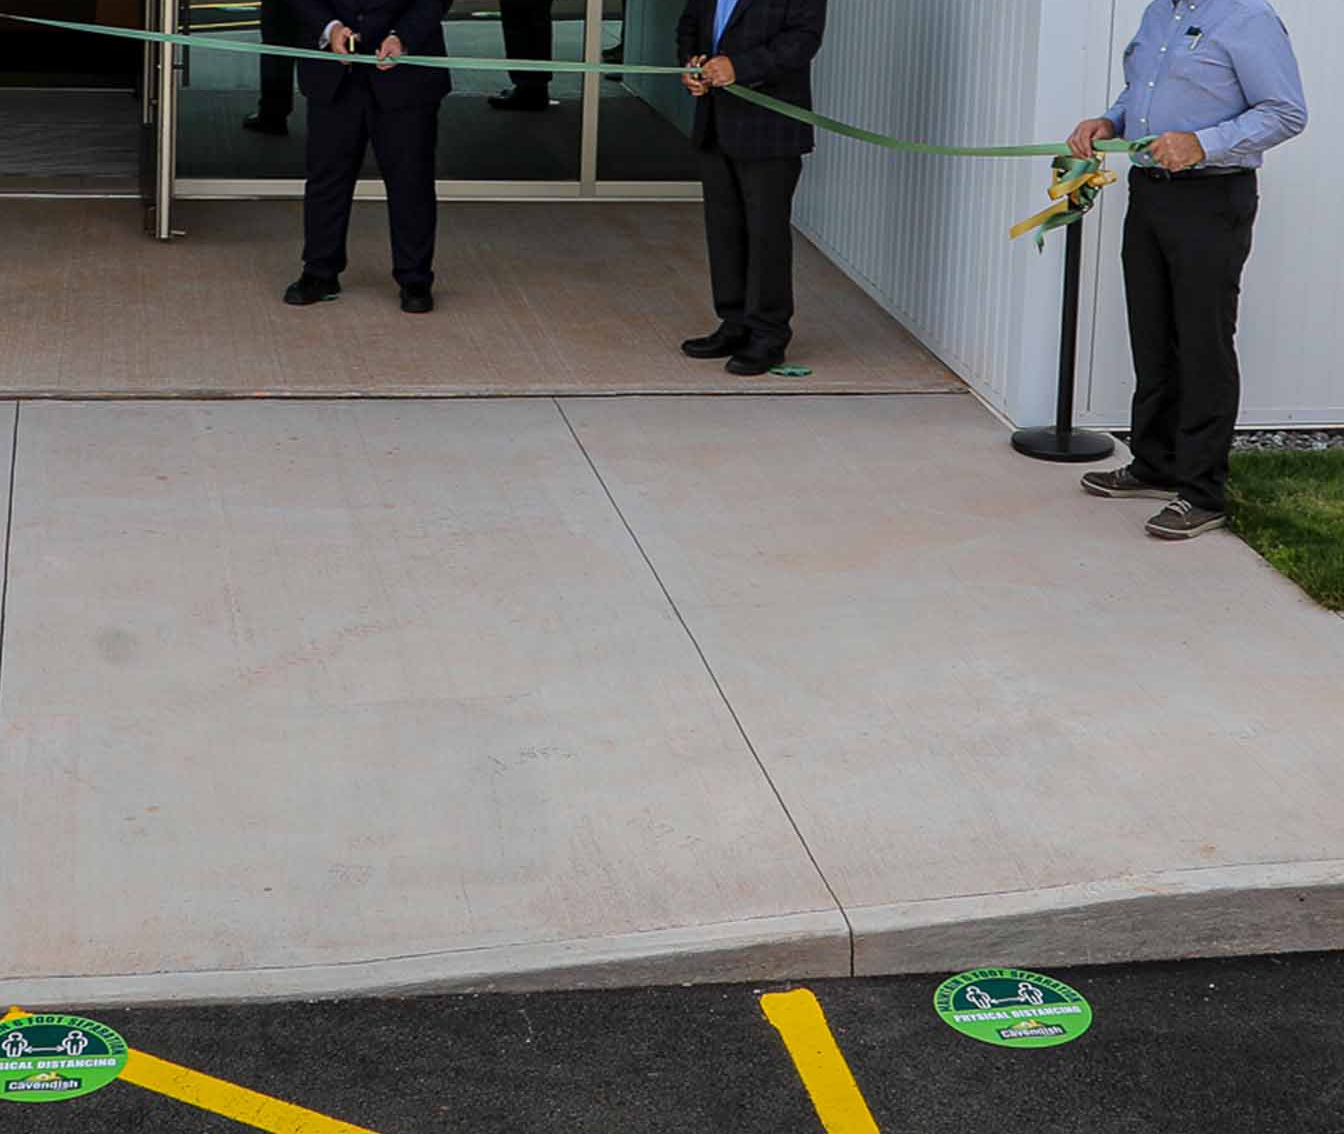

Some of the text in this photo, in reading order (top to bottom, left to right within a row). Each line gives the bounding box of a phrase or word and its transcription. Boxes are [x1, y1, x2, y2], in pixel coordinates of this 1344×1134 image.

[27, 1016, 64, 1025] FOOT
[953, 1005, 1082, 1023] PHYSICAL DISTANCING
[1000, 1025, 1064, 1039] Cavendish
[37, 1057, 117, 1070] DISTANCING
[8, 1079, 79, 1091] Cavendish
